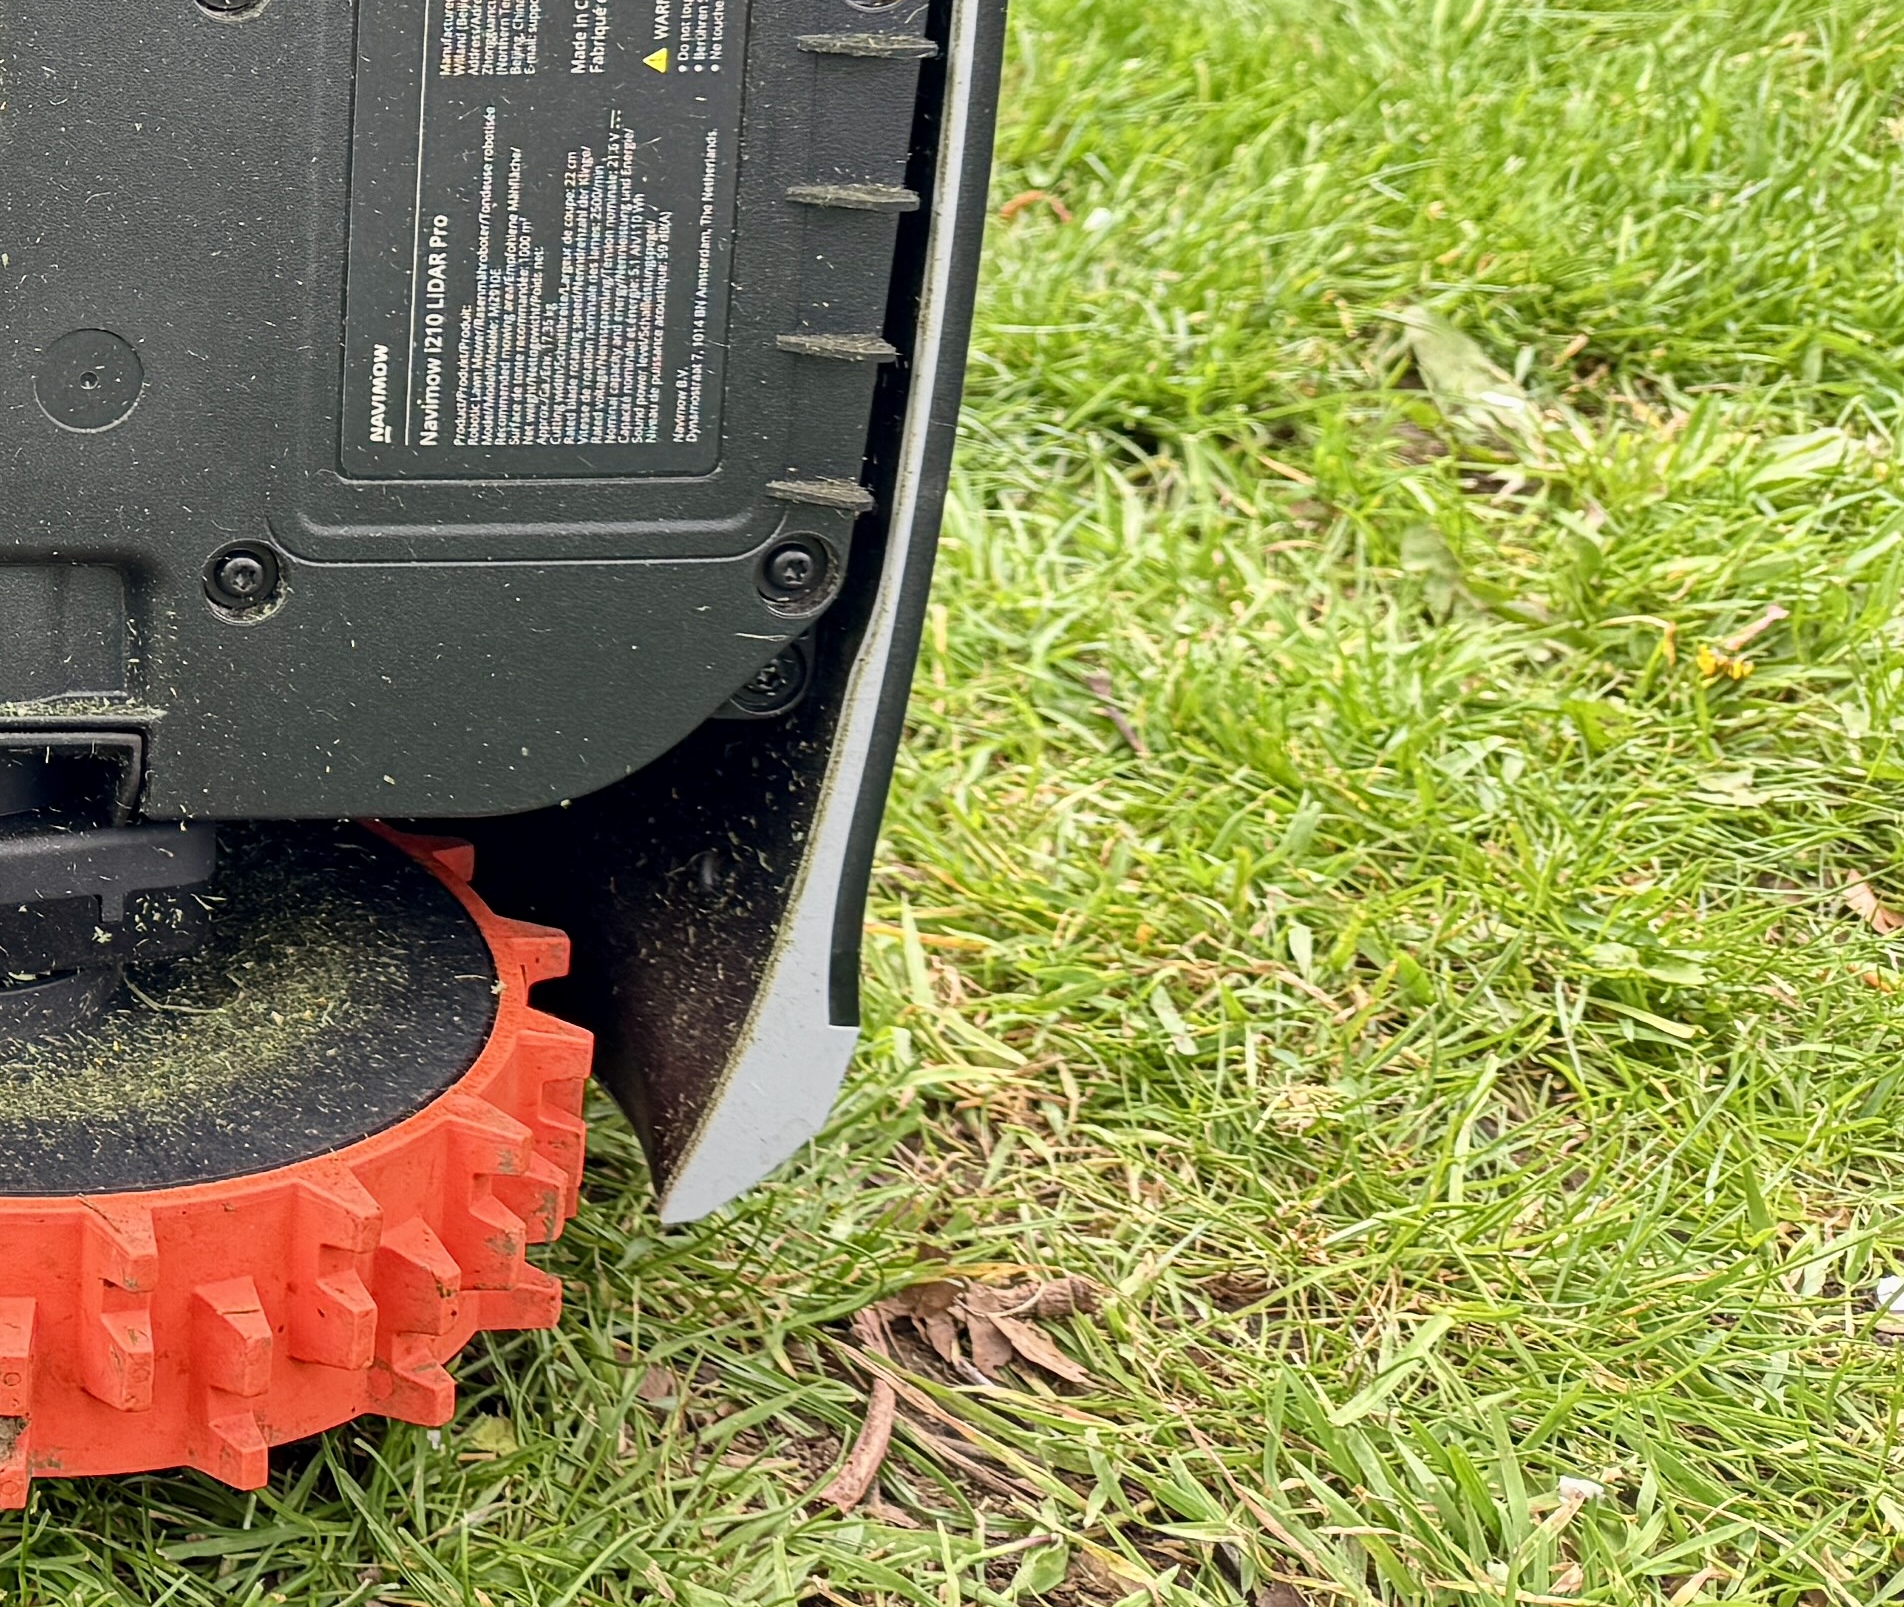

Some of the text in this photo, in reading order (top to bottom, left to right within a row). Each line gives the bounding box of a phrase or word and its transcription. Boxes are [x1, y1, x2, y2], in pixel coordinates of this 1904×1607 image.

[572, 13, 588, 28] in
[589, 7, 610, 73] Fabriqué
[679, 22, 691, 41] not
[693, 5, 708, 60] Berühren
[495, 18, 513, 75] (Northern
[524, 35, 537, 74] E-mail:
[570, 32, 587, 74] Made
[677, 44, 690, 60] Do
[710, 43, 722, 60] Ne
[482, 105, 496, 161] robotisée
[608, 132, 620, 141] V
[620, 127, 637, 175] Energie/
[564, 172, 576, 187] 22
[565, 151, 577, 169] cm
[562, 189, 578, 227] coupe:
[576, 189, 589, 208] der
[604, 170, 618, 222] nominale:
[619, 178, 631, 201] und
[632, 193, 644, 213] Wh
[428, 214, 449, 248] Pro
[518, 235, 531, 263] 1000
[561, 230, 573, 245] de
[628, 259, 640, 275] 5.1
[686, 127, 718, 442] Dynamostraat 7, 1014 BN Amsterdam, The Netherlands.
[513, 267, 529, 351] recommandée:
[543, 303, 557, 316] kg
[577, 165, 605, 444] Vitesse de rotation nominale des lames: 2500/min
[625, 279, 641, 324] énergie:
[653, 261, 670, 326] acoustique:
[422, 313, 444, 353] i210
[499, 313, 515, 359] mowing
[522, 426, 534, 445] Net
[531, 246, 544, 269] net:
[541, 320, 554, 349] 17.35
[567, 331, 584, 375] rotating
[610, 325, 623, 346] and
[453, 304, 472, 446] Product/Produkt/Produit:
[511, 354, 525, 384] tonte
[608, 348, 624, 394] capacity
[621, 341, 635, 393] nominale
[649, 329, 666, 384] puissance
[368, 343, 389, 442] NAVIMOW
[417, 357, 442, 446] Navimow
[469, 372, 482, 401] Lawn
[494, 362, 510, 446] Recommended
[510, 386, 523, 402] de
[565, 378, 578, 409] blade
[632, 370, 650, 443] Sound power
[648, 387, 660, 402] de
[672, 366, 688, 443] Navimow B.V.
[466, 404, 480, 446] Robotic
[508, 404, 522, 446] Surface
[549, 404, 565, 445] Cutting
[563, 413, 576, 444] Rated
[591, 411, 604, 444] Rated
[605, 397, 618, 444] Nominal
[618, 396, 634, 444] Capacité
[646, 404, 659, 443] Niveau
